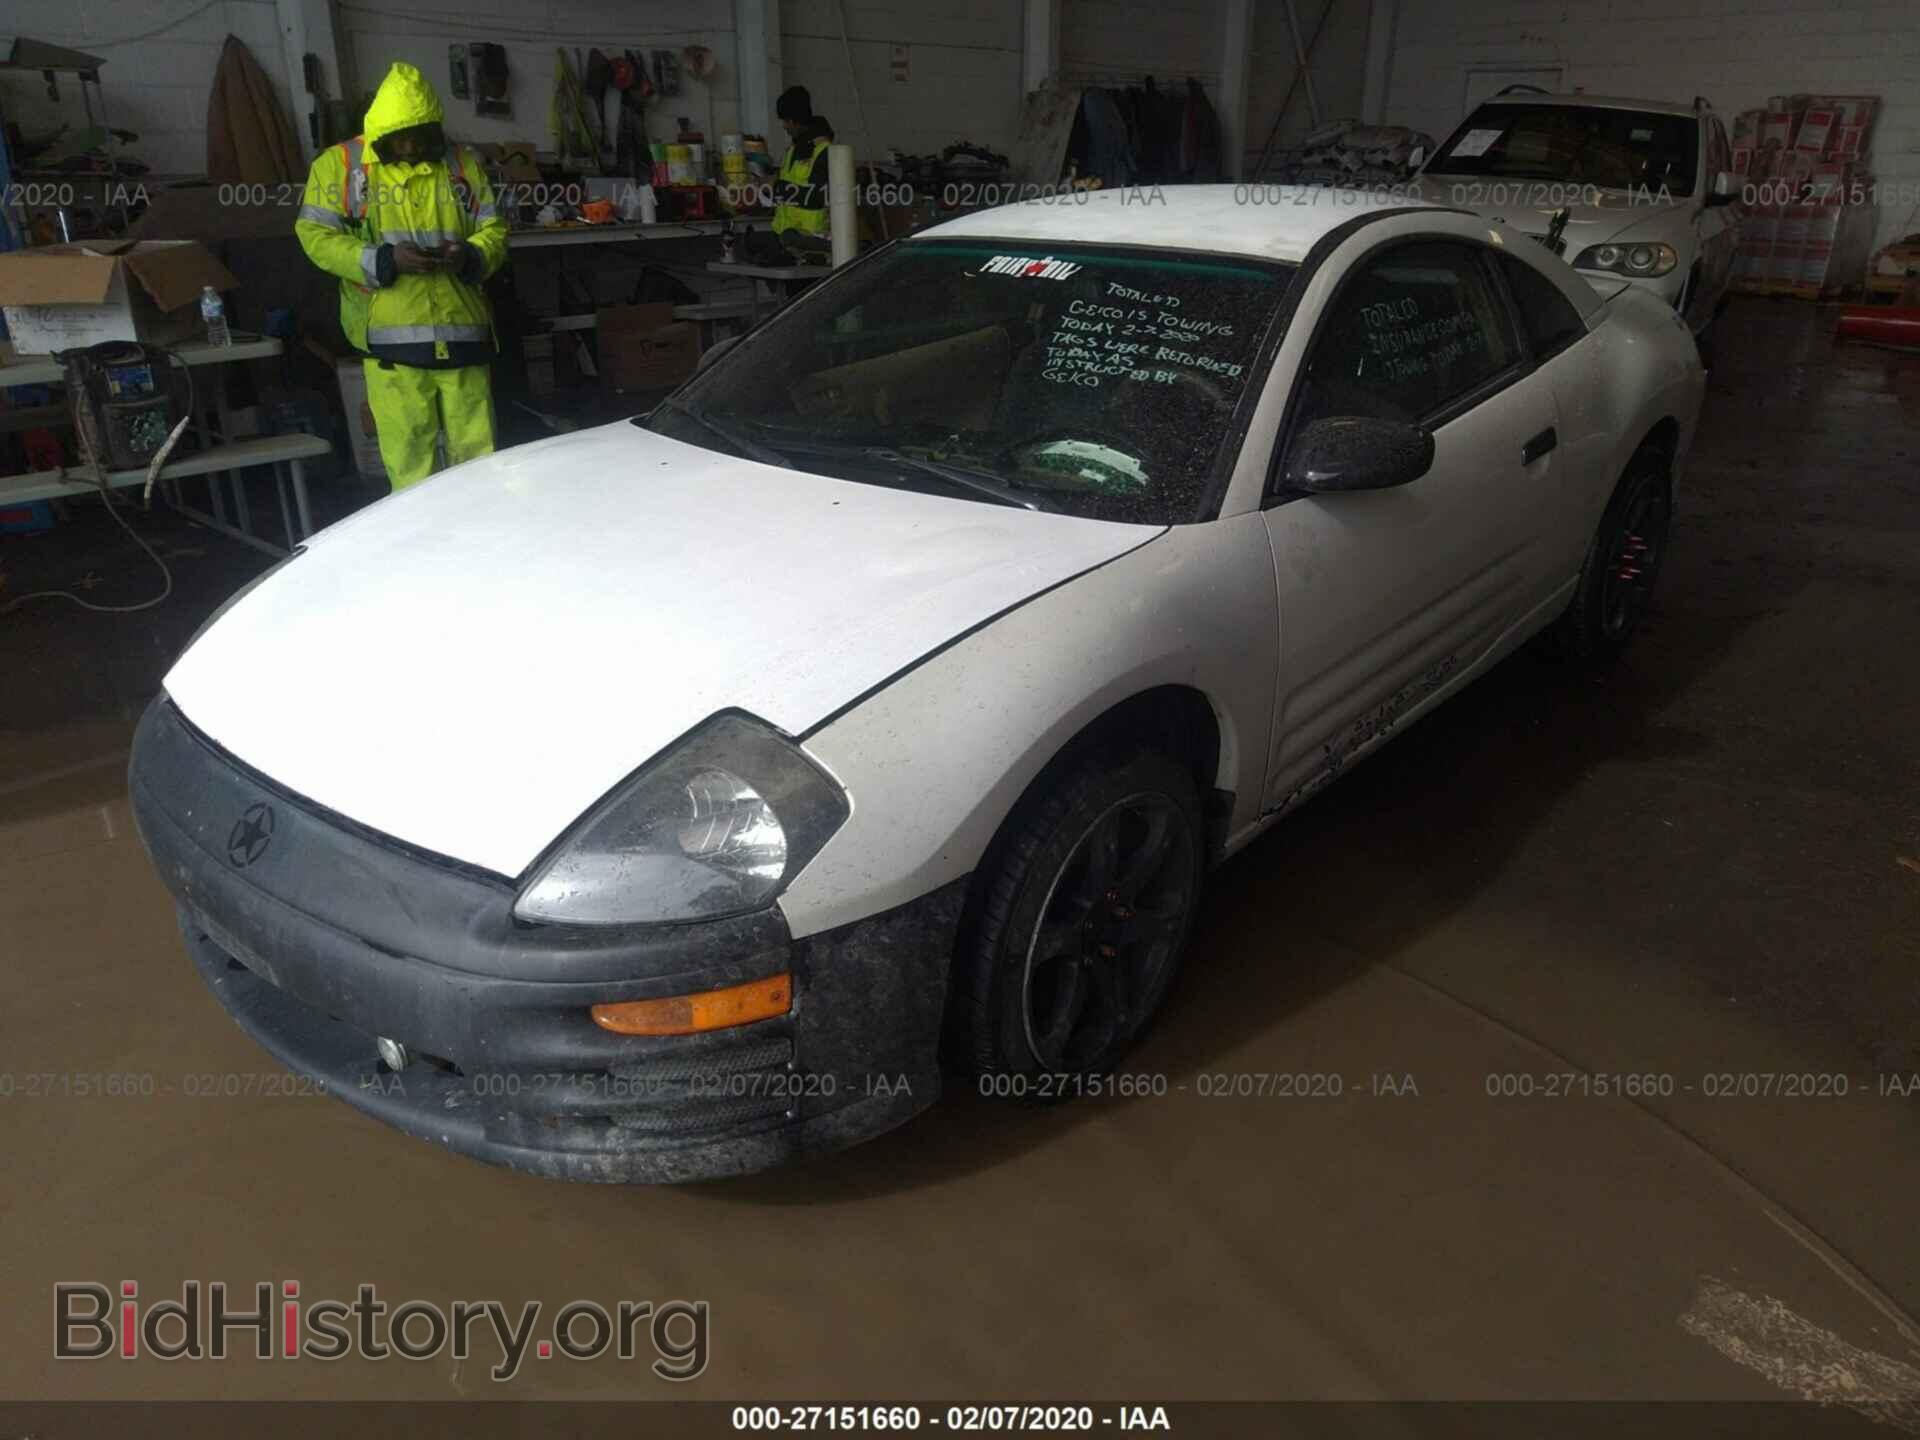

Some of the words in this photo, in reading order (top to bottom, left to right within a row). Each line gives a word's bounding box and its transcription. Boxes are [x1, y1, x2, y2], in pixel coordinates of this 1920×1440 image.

[1107, 281, 1181, 308] TOTALED
[1060, 315, 1116, 336] TODAY
[1068, 300, 1124, 320] GEICO
[1127, 309, 1149, 321] IS
[1157, 311, 1236, 337] TOWING
[1052, 331, 1099, 348] TAGS
[1104, 339, 1151, 355] WERE
[1105, 353, 1136, 367] AS
[1040, 368, 1100, 388] GEICO
[1154, 371, 1178, 386] BY
